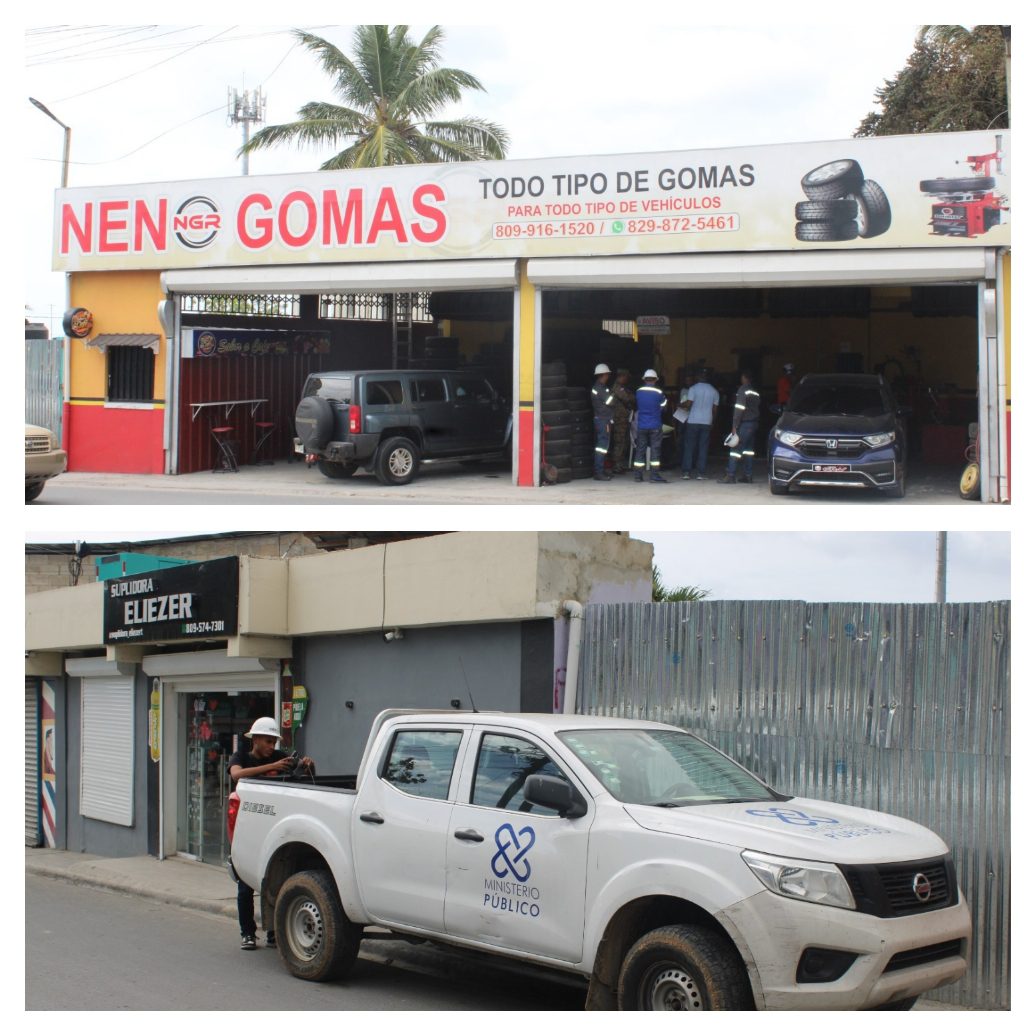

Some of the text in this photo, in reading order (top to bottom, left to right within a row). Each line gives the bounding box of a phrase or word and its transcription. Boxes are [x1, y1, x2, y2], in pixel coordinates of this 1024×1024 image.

[478, 163, 756, 200] TODO TIPO DE GOMAS
[236, 183, 447, 249] GOMAS
[507, 196, 722, 217] PARA TODO TIPO DE VEHÍCULOS
[173, 213, 221, 231] NGR
[495, 221, 595, 238] 809-916-1520
[627, 215, 735, 233] 829-872-5461
[110, 578, 154, 598] SUPLIDORA
[124, 592, 193, 625] ELIEZER
[185, 620, 225, 634] 809-574-7301
[484, 878, 540, 900] MINISTERIO
[483, 892, 540, 917] PÚBLICO
